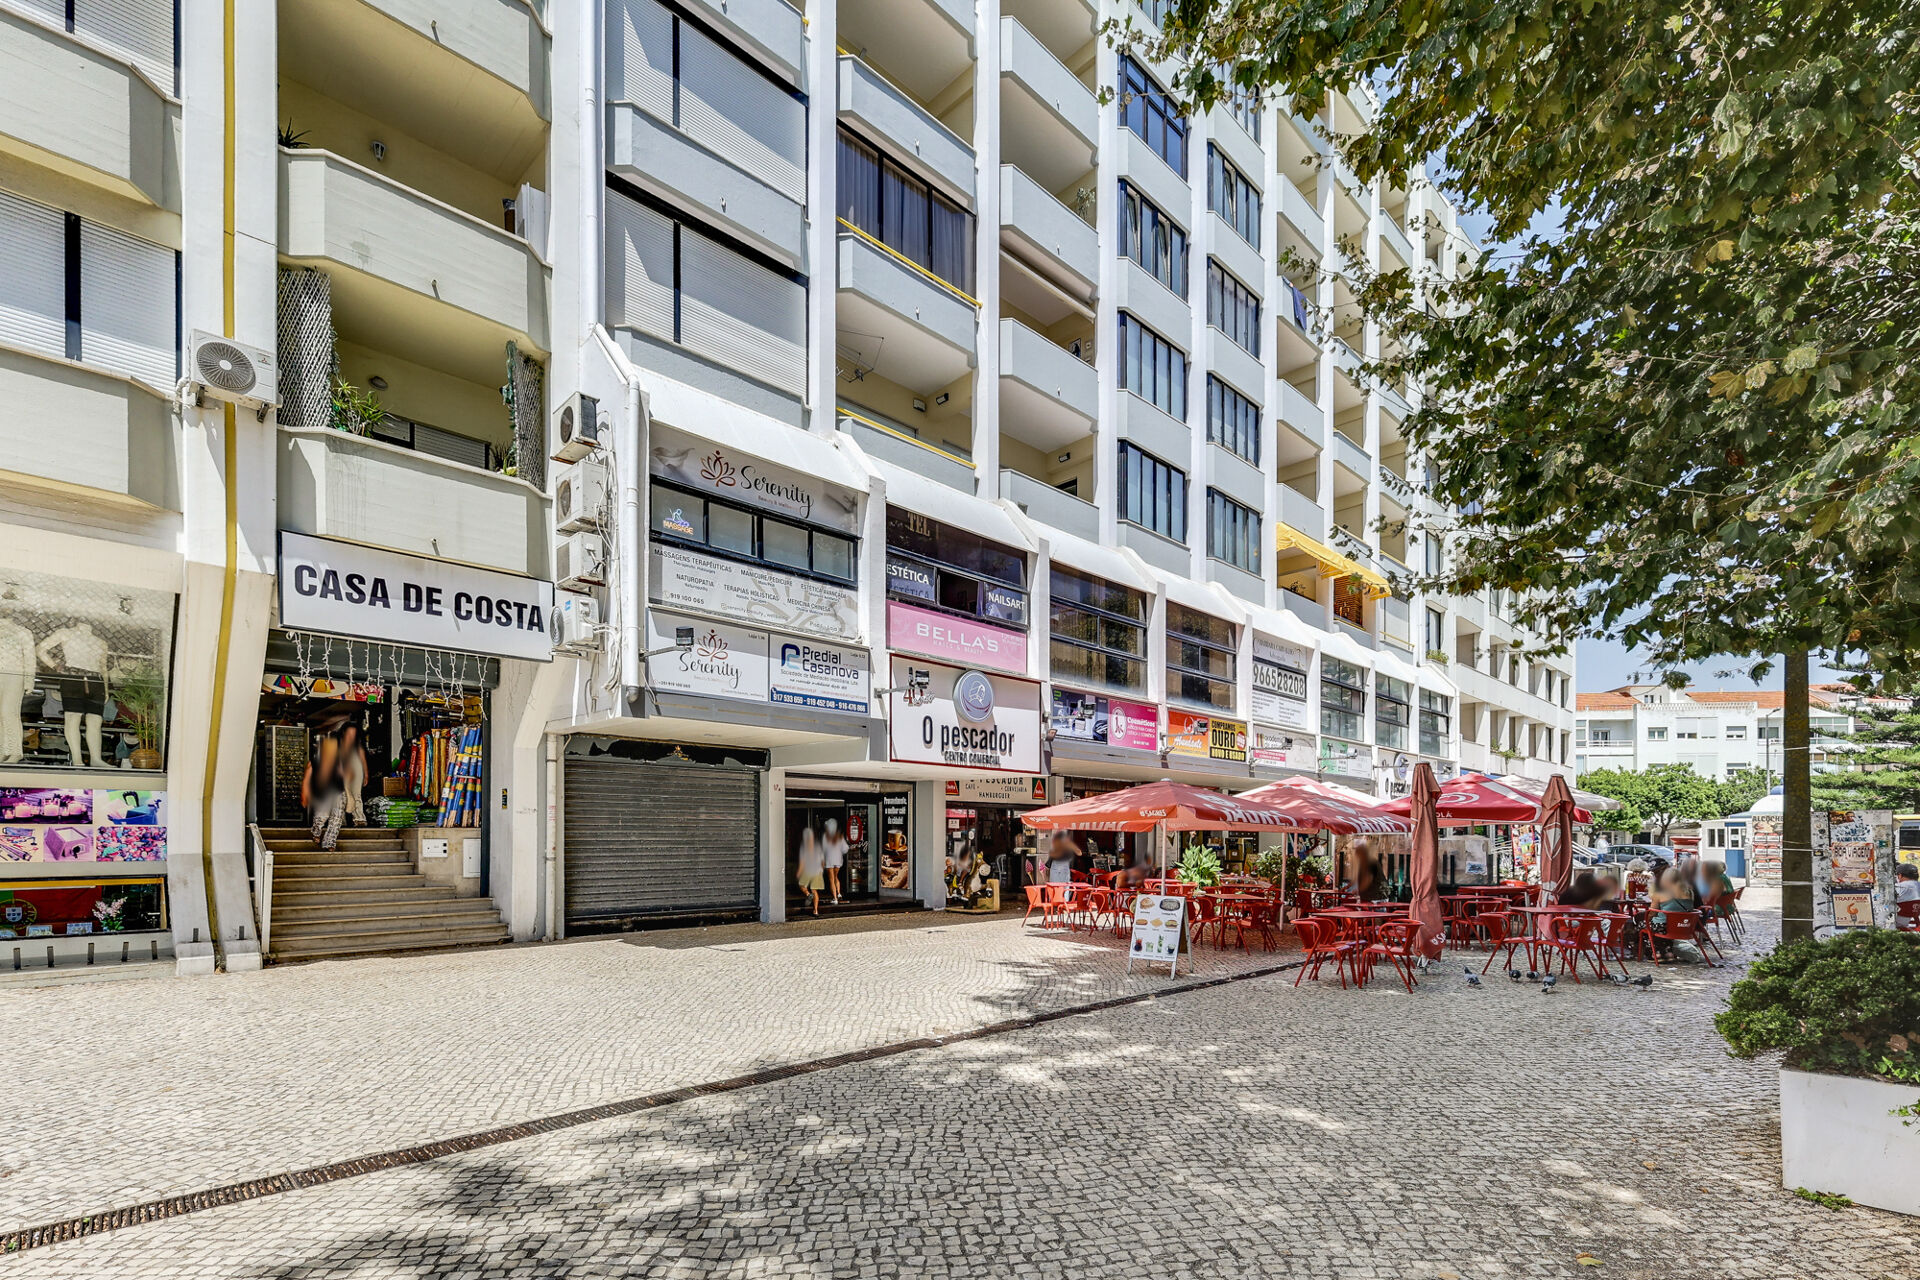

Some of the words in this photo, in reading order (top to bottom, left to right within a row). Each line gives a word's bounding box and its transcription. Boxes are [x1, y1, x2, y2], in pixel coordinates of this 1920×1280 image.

[741, 466, 814, 519] Serenity
[662, 520, 694, 535] MASSAGE
[654, 549, 690, 563] MASSAGENS
[676, 574, 715, 587] NATUROPATIA
[740, 569, 793, 587] MANICURE/PEDICURE
[886, 563, 930, 585] ESTÉTICA
[294, 564, 392, 610] CASA
[403, 581, 443, 617] DE
[454, 591, 545, 633] COSTA
[670, 592, 681, 600] 919
[692, 597, 705, 605] 065
[724, 584, 750, 596] TERAPIAS
[787, 598, 811, 609] MEDICINA
[810, 603, 831, 613] CHINESA
[988, 592, 1026, 611] NAILSART
[802, 646, 842, 664] Predial
[679, 651, 743, 689] Serenity
[802, 659, 859, 680] Casanova
[773, 693, 783, 701] 917
[784, 694, 793, 703] 533
[922, 715, 934, 745] O
[941, 724, 1015, 753] pescador
[1211, 720, 1236, 732] COMPRAMOS
[1211, 729, 1236, 748] OURO
[945, 751, 968, 764] CENTRO
[969, 753, 1000, 767] COMERCIAL
[1211, 748, 1225, 759] NOVO
[1225, 750, 1229, 760] E
[1229, 750, 1245, 761] USADO
